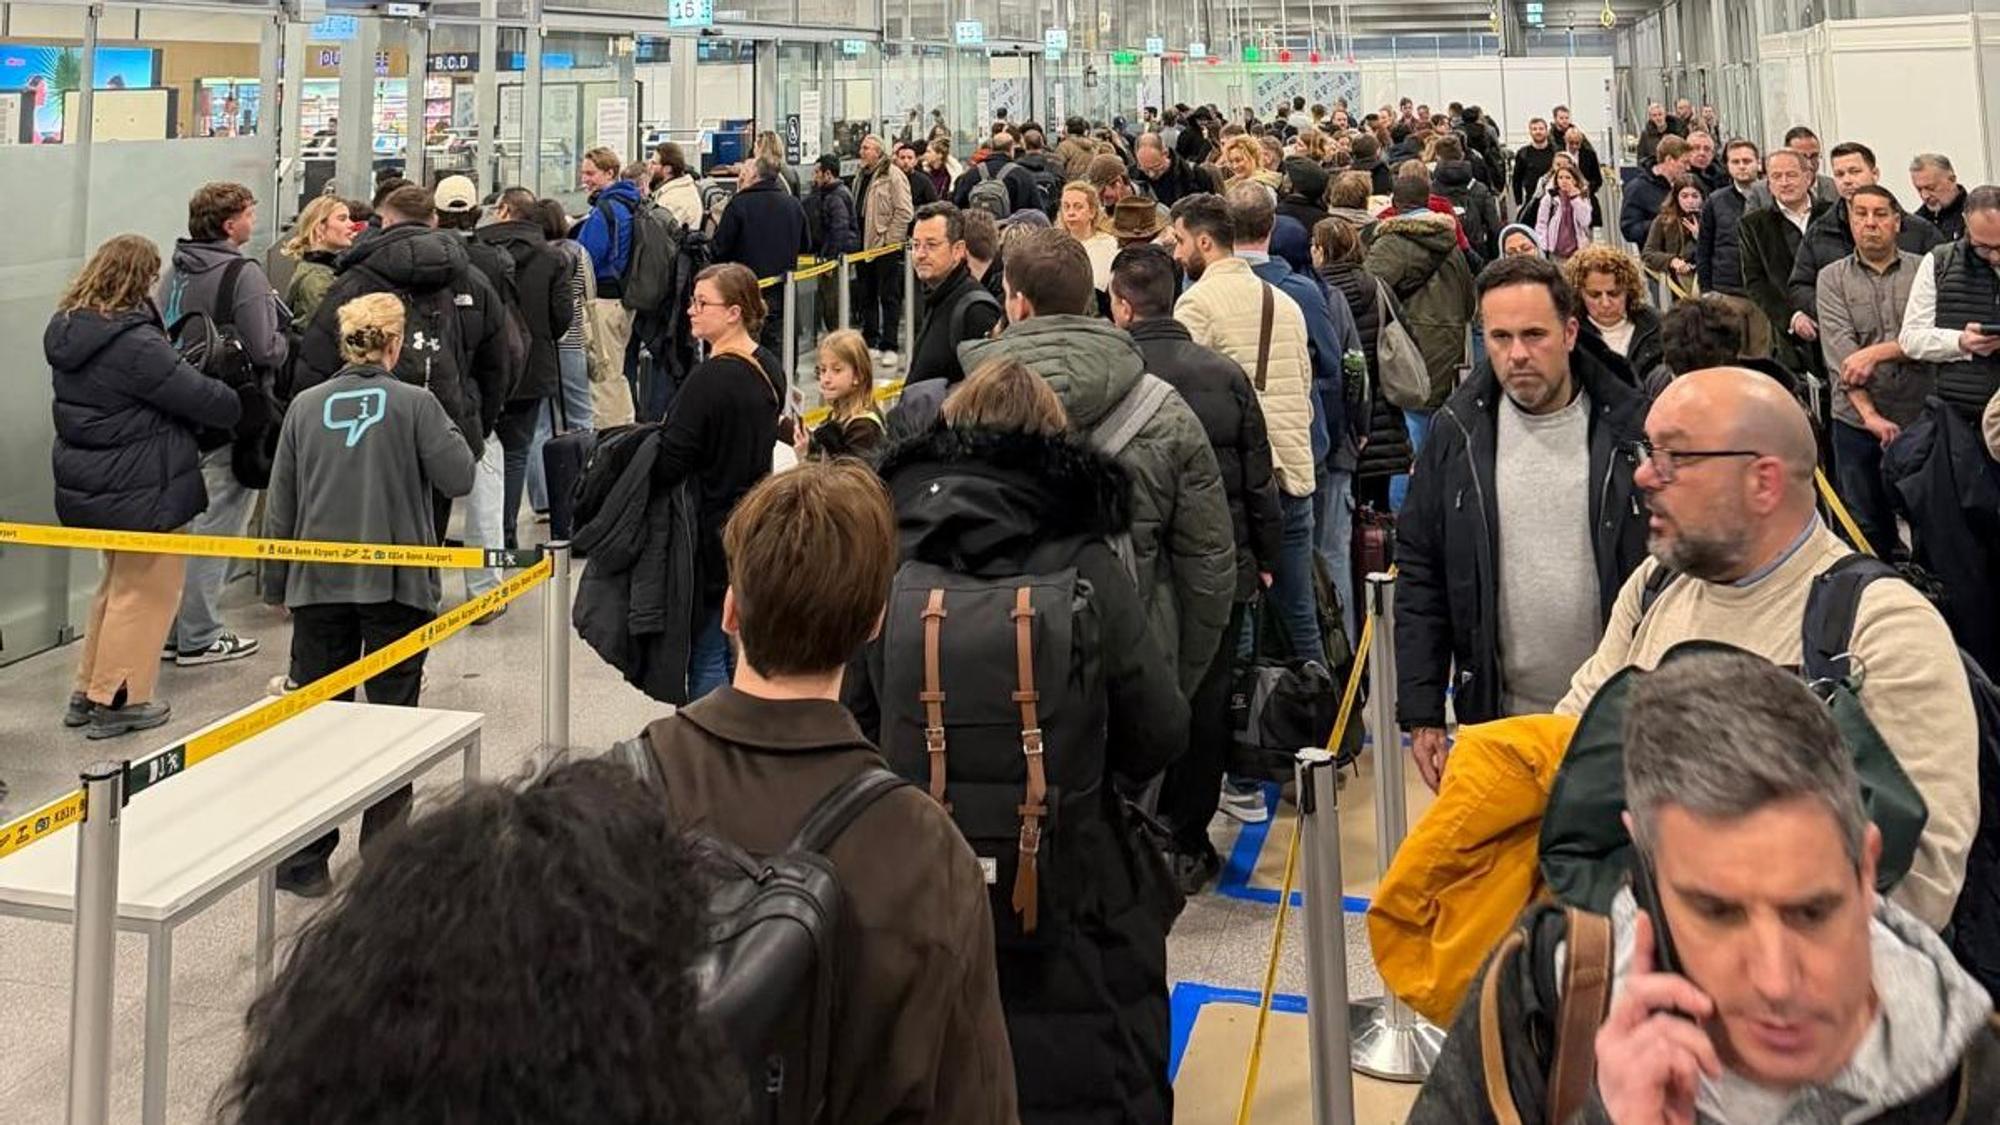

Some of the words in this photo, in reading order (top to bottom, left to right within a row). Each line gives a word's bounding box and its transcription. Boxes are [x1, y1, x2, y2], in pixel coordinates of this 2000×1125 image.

[675, 1, 695, 19] 16
[314, 547, 340, 558] Airport
[426, 551, 453, 564] Airport
[54, 805, 77, 821] Köln
